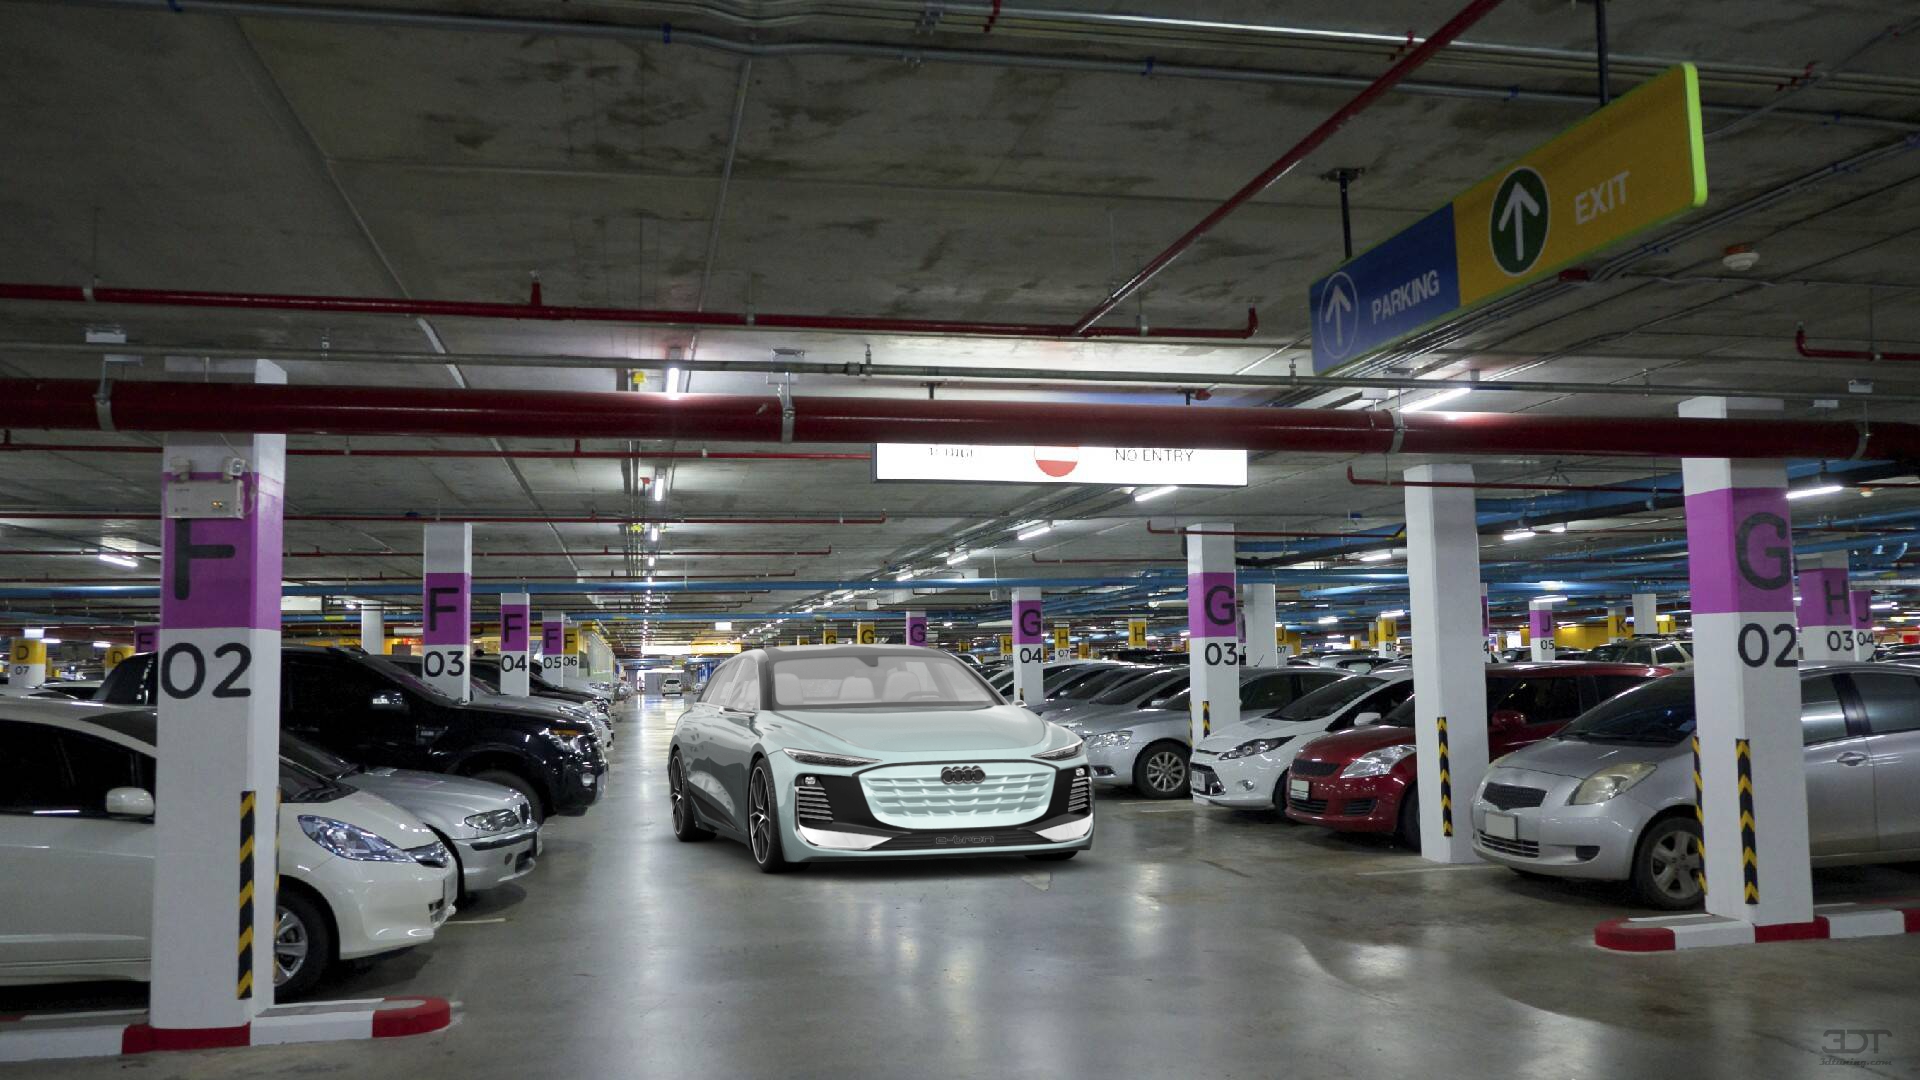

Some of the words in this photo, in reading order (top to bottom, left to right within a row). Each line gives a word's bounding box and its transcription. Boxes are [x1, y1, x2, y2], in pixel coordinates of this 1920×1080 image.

[1574, 171, 1631, 226] EXIT
[1372, 269, 1440, 325] PARKING
[1115, 448, 1138, 462] NO
[1143, 448, 1194, 462] ENTRY
[1735, 511, 1791, 591] G
[1204, 585, 1236, 626] G
[1824, 579, 1850, 615] H
[429, 587, 459, 632] F
[1858, 597, 1870, 623] J
[504, 613, 523, 643] F
[1020, 609, 1042, 637] G
[1542, 615, 1551, 632] J
[1616, 618, 1626, 633] K
[545, 628, 559, 649] F
[564, 633, 576, 649] F
[861, 629, 875, 644] G
[910, 623, 926, 643] G
[1058, 628, 1068, 644] H
[1133, 626, 1146, 642] H
[1826, 630, 1855, 652] 03
[1857, 632, 1874, 646] 04
[15, 645, 30, 661] D
[1003, 639, 1012, 652] H
[1540, 639, 1555, 650] 05
[1737, 622, 1799, 668] 02
[112, 650, 124, 664] D
[563, 656, 578, 667] 06
[1019, 647, 1043, 664] 04
[1058, 649, 1070, 658] 07
[1205, 642, 1239, 666] 03
[15, 665, 30, 675] 07
[160, 642, 252, 700] 02
[424, 650, 465, 677] 03
[501, 654, 528, 673] 04
[543, 656, 562, 669] 05
[935, 834, 995, 845] e-tron
